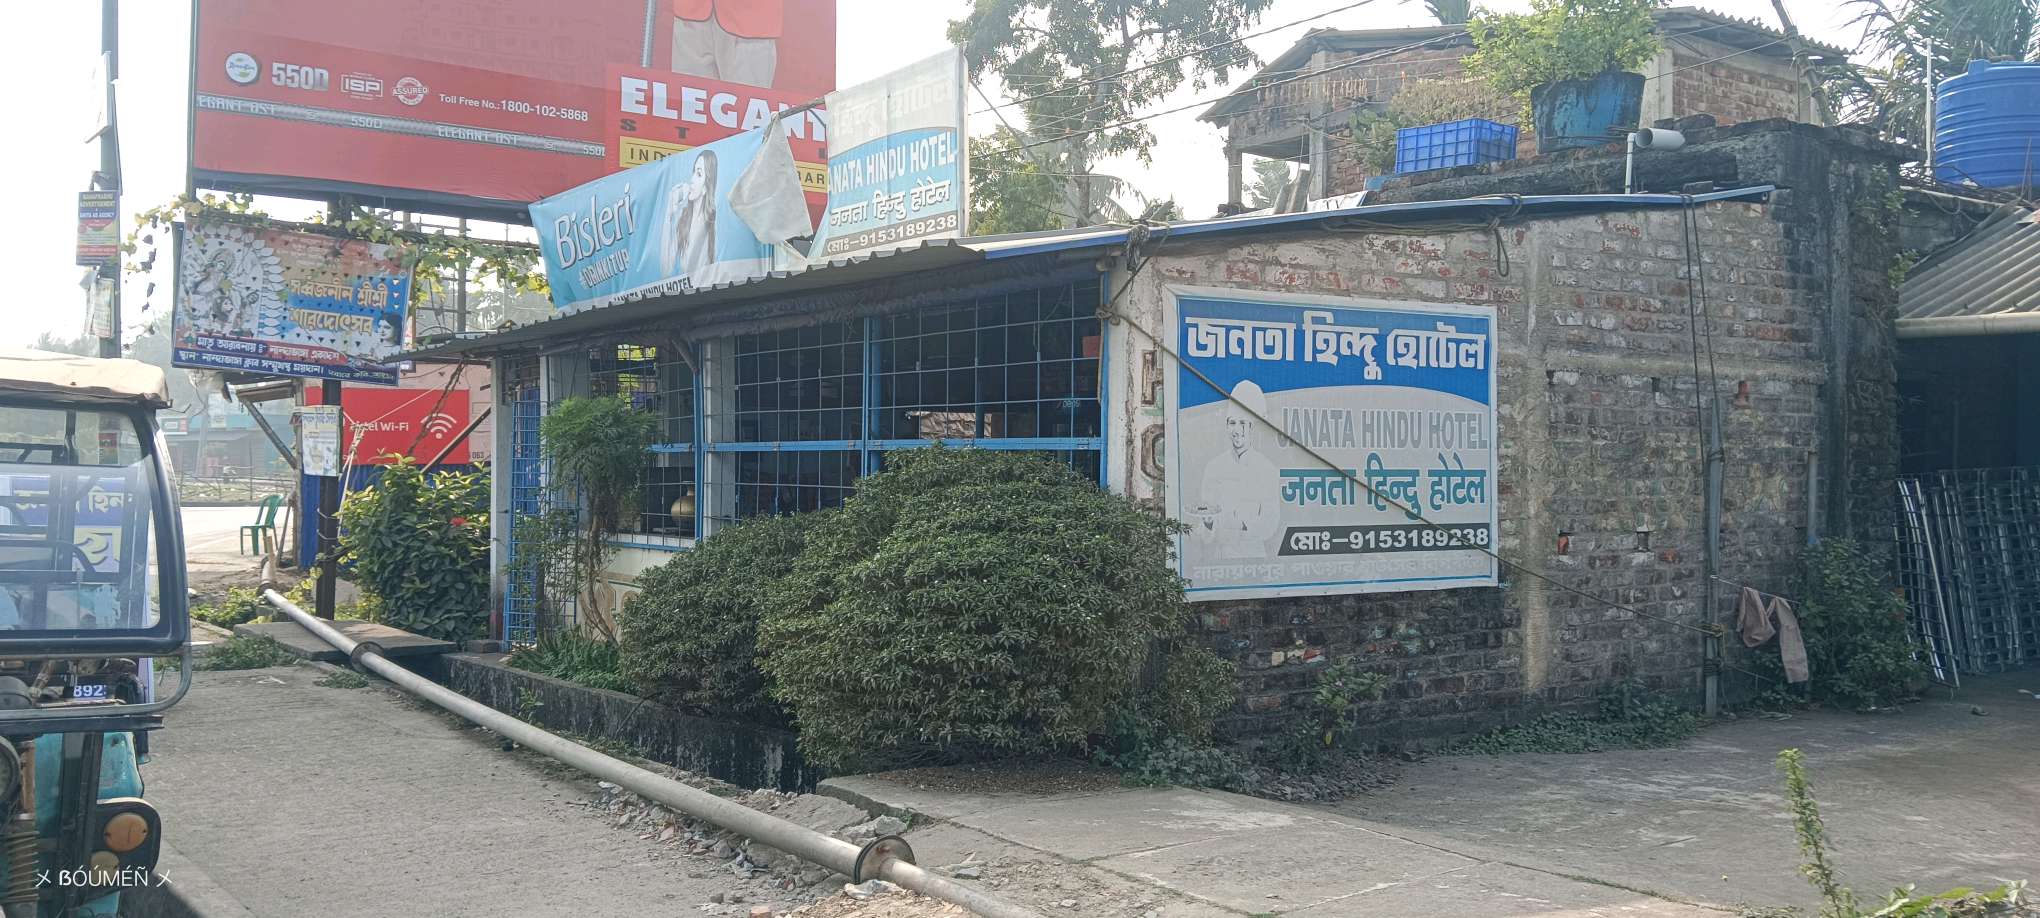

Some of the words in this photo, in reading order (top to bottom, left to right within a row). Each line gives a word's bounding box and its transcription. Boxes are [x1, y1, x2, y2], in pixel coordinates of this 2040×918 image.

[439, 93, 457, 104] Toll
[459, 96, 480, 107] Free
[866, 144, 906, 185] HINDU
[910, 131, 955, 172] HOTEL
[554, 182, 636, 270] Bisleri
[666, 276, 694, 294] HOTEL
[1185, 316, 1297, 362] জনতা
[1302, 310, 1383, 381] হিন্দু
[1386, 321, 1487, 370] হোটেল
[380, 421, 409, 432] Wi-Fi
[1278, 407, 1355, 450] JANATA
[1361, 408, 1423, 450] HINDU
[1428, 411, 1489, 450] HOTEL
[1279, 468, 1357, 506] जनता
[1364, 452, 1422, 520] हिन्दु
[1427, 452, 1487, 512] होटेल
